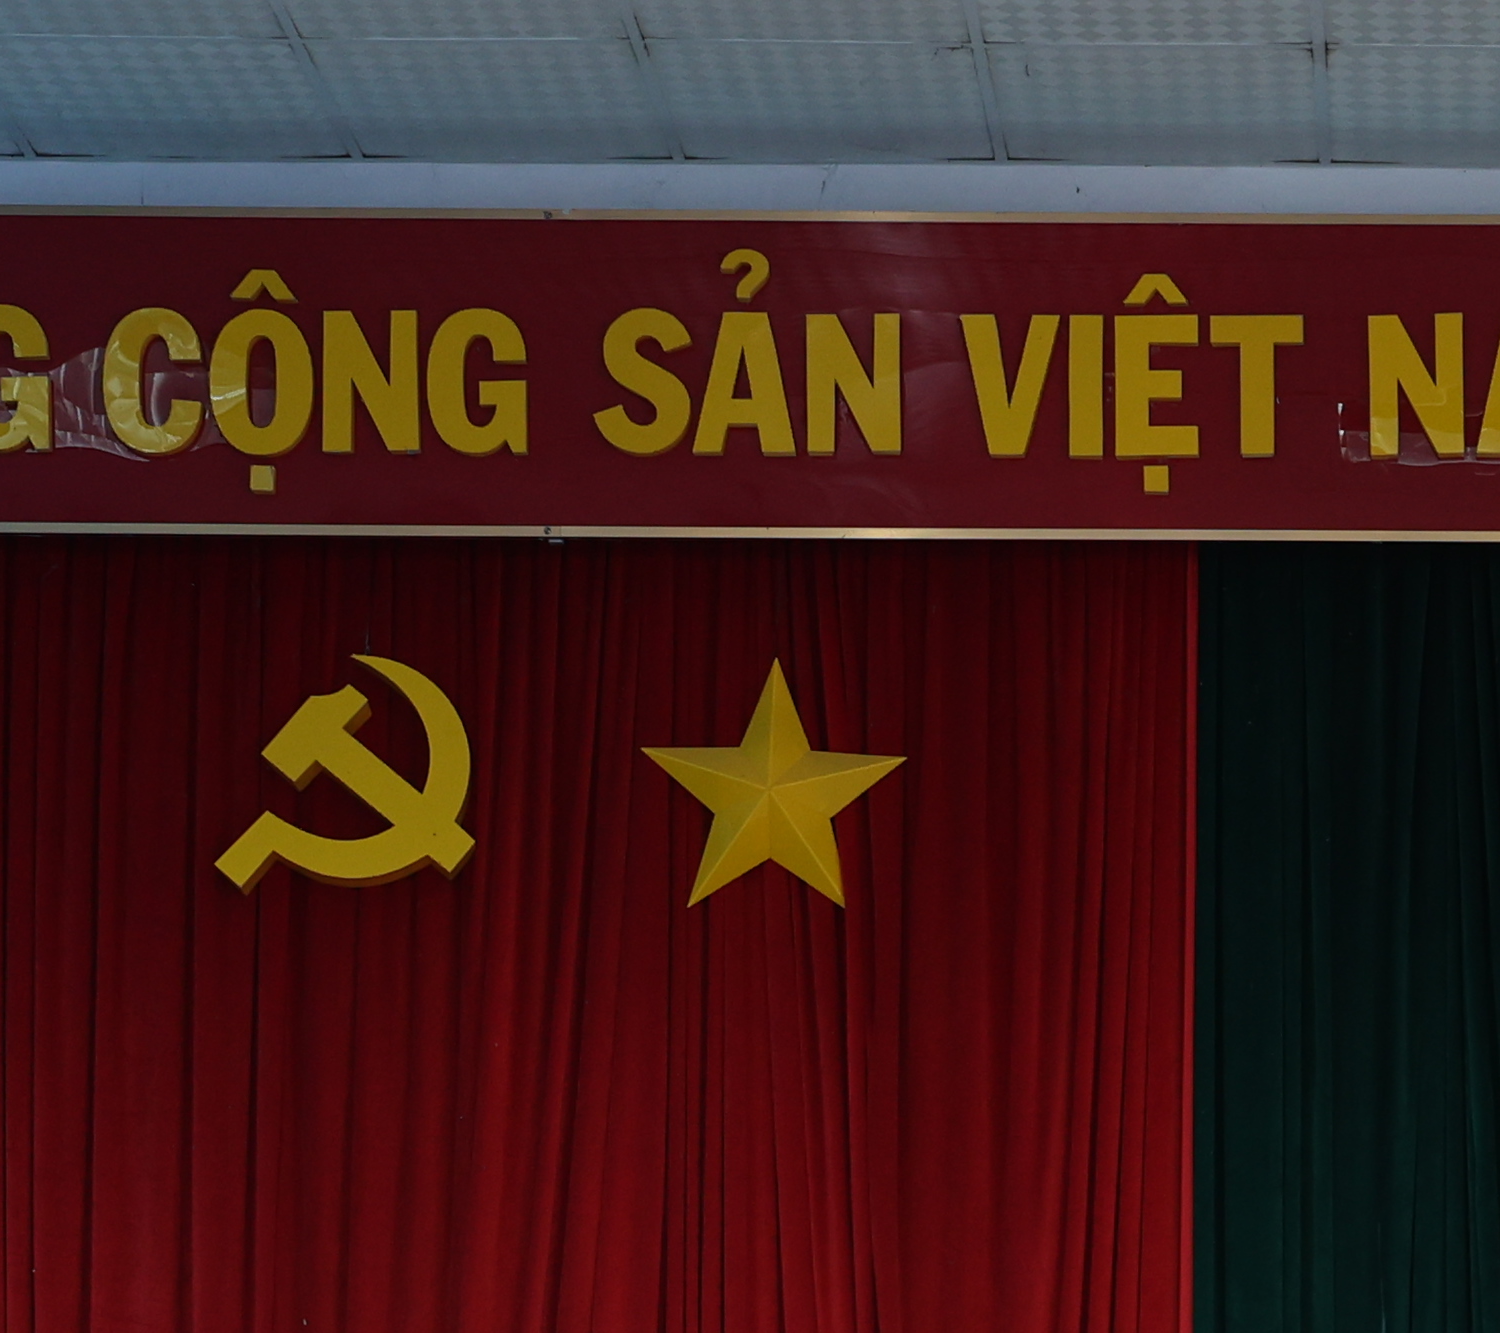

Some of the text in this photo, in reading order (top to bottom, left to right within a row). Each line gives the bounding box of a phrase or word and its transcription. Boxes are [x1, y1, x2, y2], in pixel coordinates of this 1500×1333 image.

[101, 268, 528, 492] CỘNG
[592, 248, 903, 456] SẢN
[959, 272, 1305, 494] VIỆT
